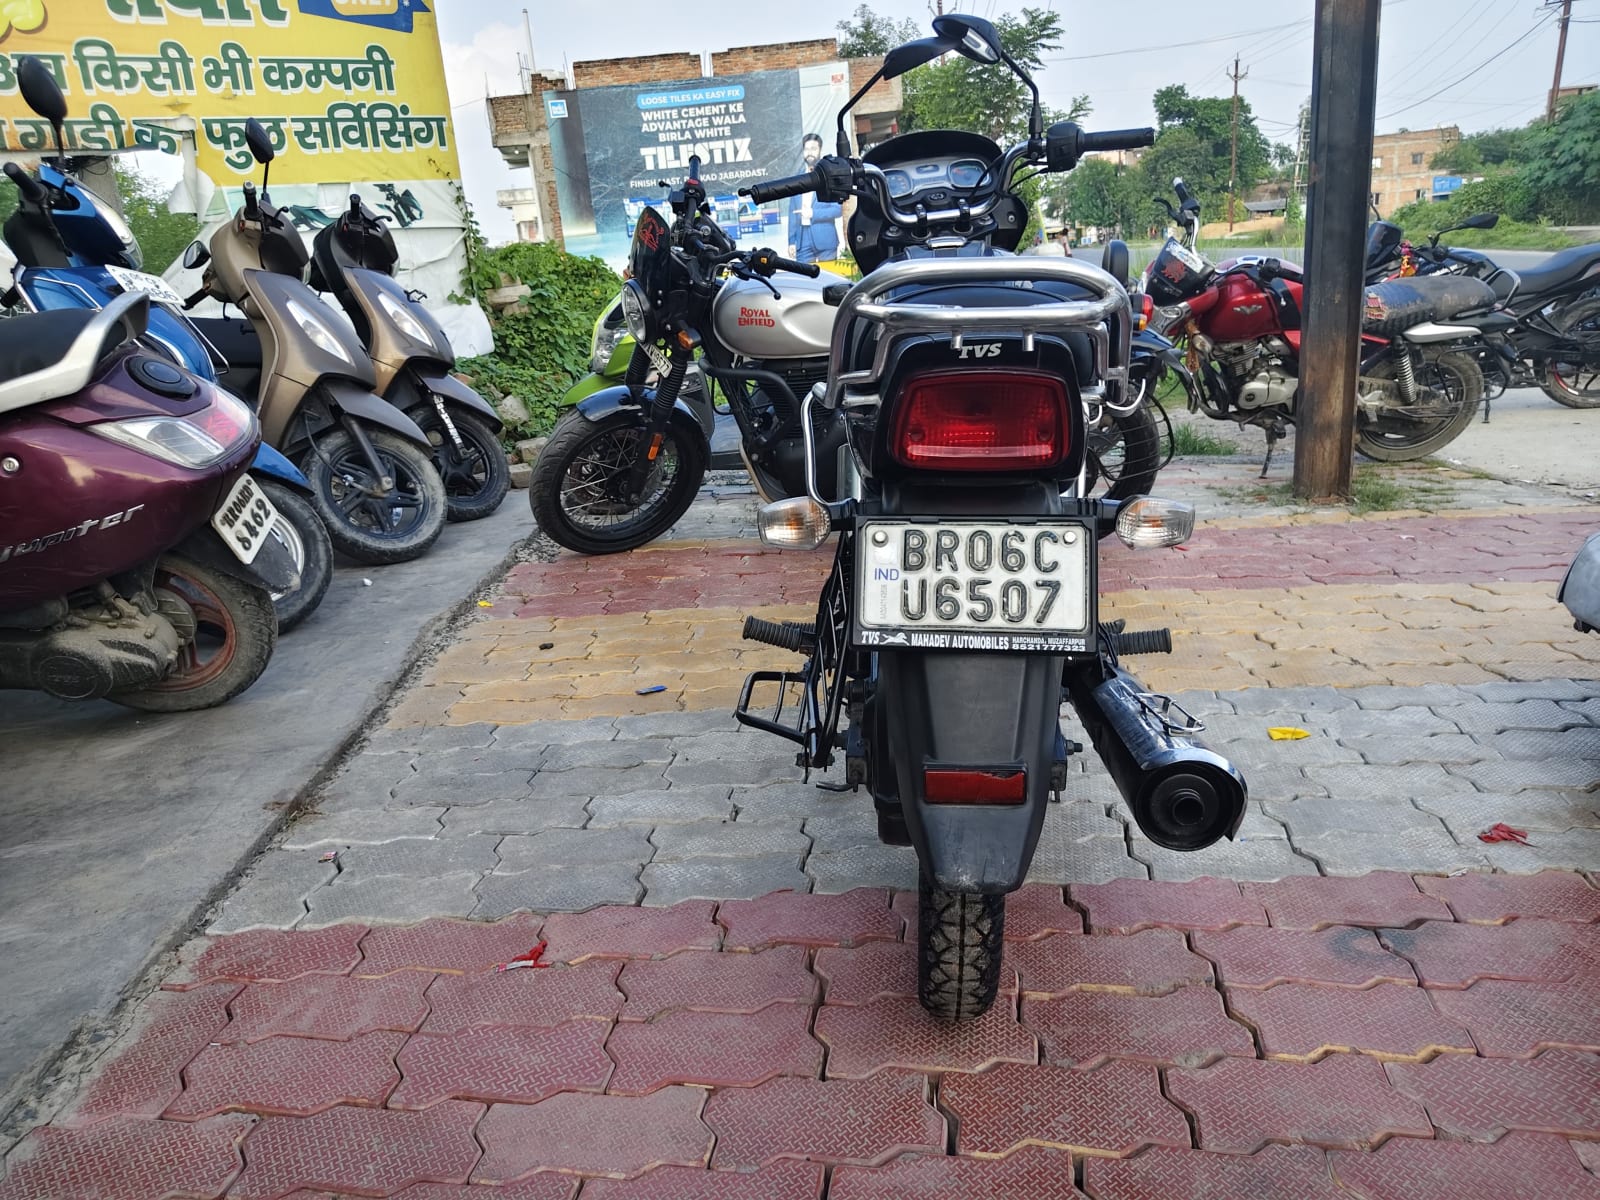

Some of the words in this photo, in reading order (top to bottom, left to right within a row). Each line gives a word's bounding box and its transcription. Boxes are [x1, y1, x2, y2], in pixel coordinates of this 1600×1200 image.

[74, 39, 194, 91] किसी
[202, 42, 252, 90] भी
[259, 45, 394, 90] कम्पनी
[641, 96, 668, 105] LOOSE
[670, 94, 691, 103] TILES
[693, 92, 704, 101] KA
[705, 90, 726, 99] EASY
[727, 88, 740, 97] FIX
[641, 109, 679, 122] WHITE
[681, 104, 726, 118] CEMENT
[729, 102, 744, 113] KE
[291, 102, 446, 149] सर्विसिंग
[641, 117, 709, 133] ADVANTAGE
[711, 113, 746, 126] WALA
[658, 130, 692, 142] BIRLA
[694, 126, 731, 139] WHITE
[640, 137, 753, 171] TILESTIX
[630, 179, 656, 189] FINISH
[719, 168, 769, 180] JABARDAST.
[740, 306, 770, 318] ROYAL
[738, 317, 775, 328] ENFIELD
[958, 342, 1002, 359] TVS
[903, 529, 1059, 573] BR06C
[874, 567, 899, 581] IND
[903, 578, 1061, 624] U6507
[861, 631, 880, 645] TVS
[911, 633, 951, 648] MAHADEV
[952, 634, 1010, 650] AUTOMOBILES
[1012, 643, 1086, 652] 8521777323
